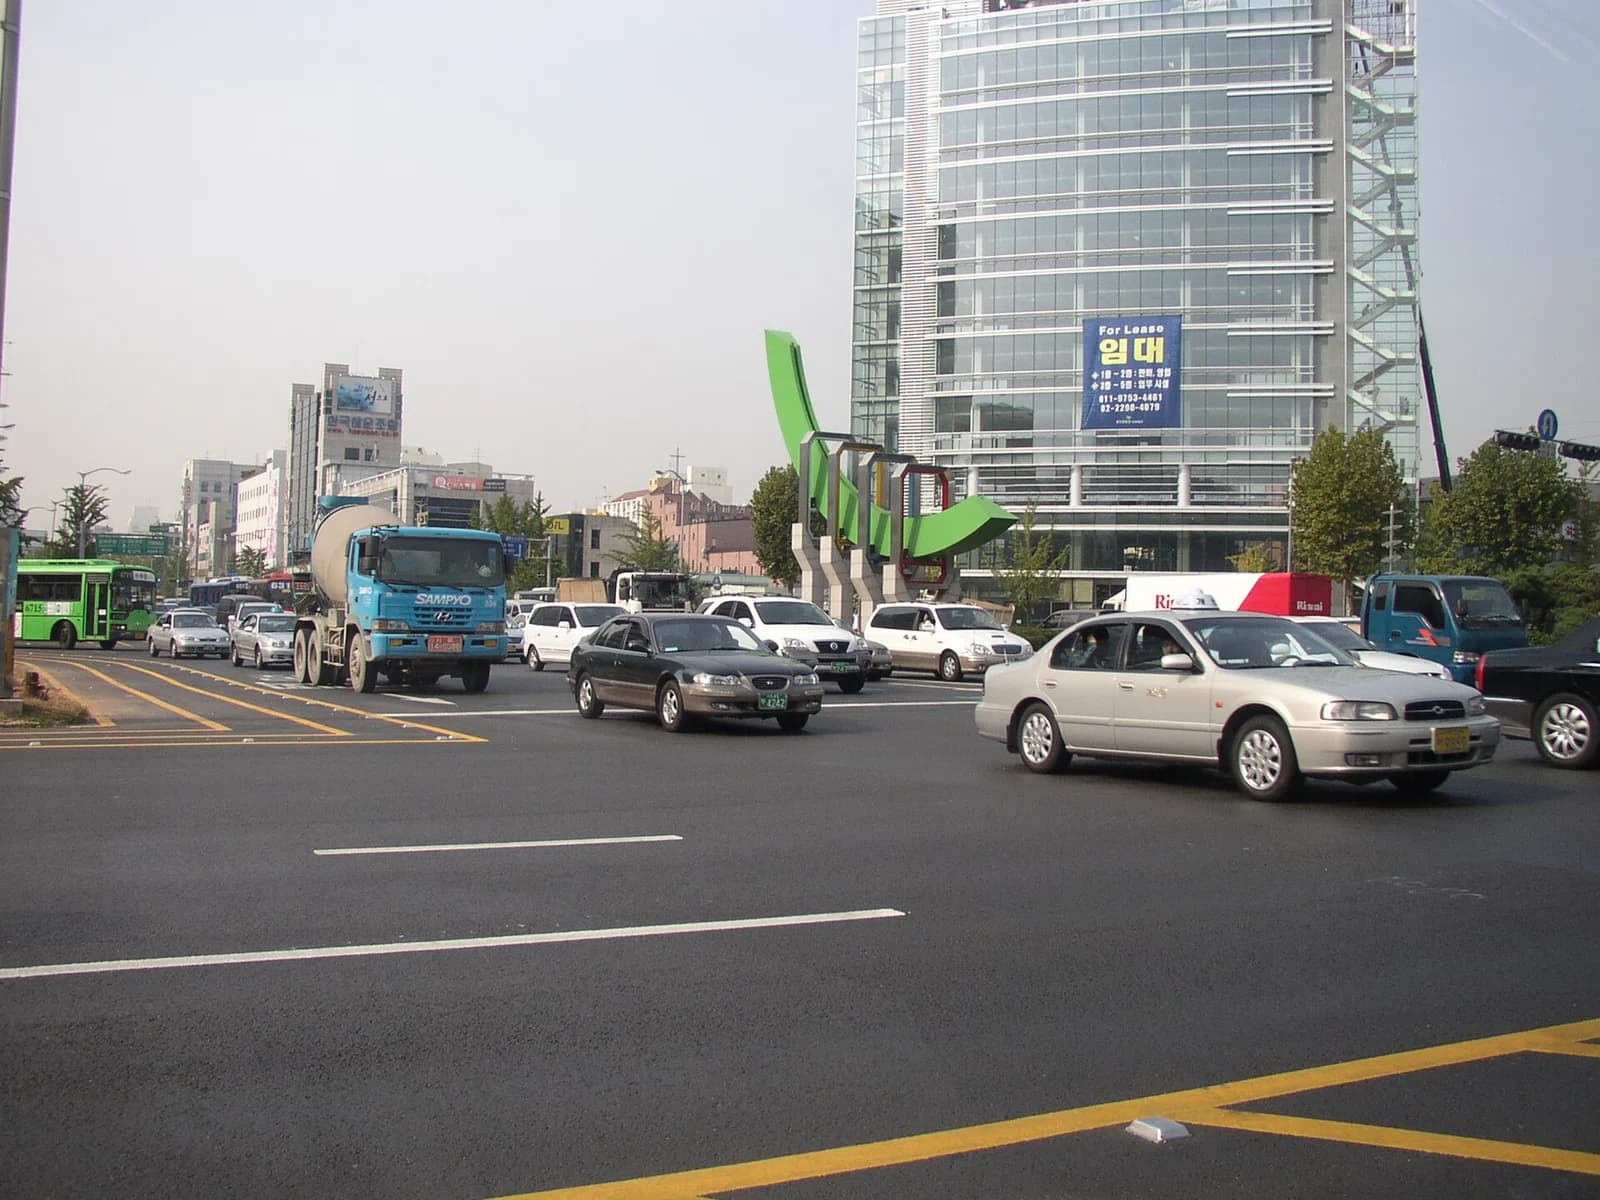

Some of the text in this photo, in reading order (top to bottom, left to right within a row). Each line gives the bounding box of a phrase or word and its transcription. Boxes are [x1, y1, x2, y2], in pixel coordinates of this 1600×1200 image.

[1099, 325, 1164, 336] For Lease
[1099, 336, 1164, 366] 임대
[271, 581, 290, 589] 631
[415, 593, 472, 606] SAMPYO
[25, 603, 43, 613] 6715
